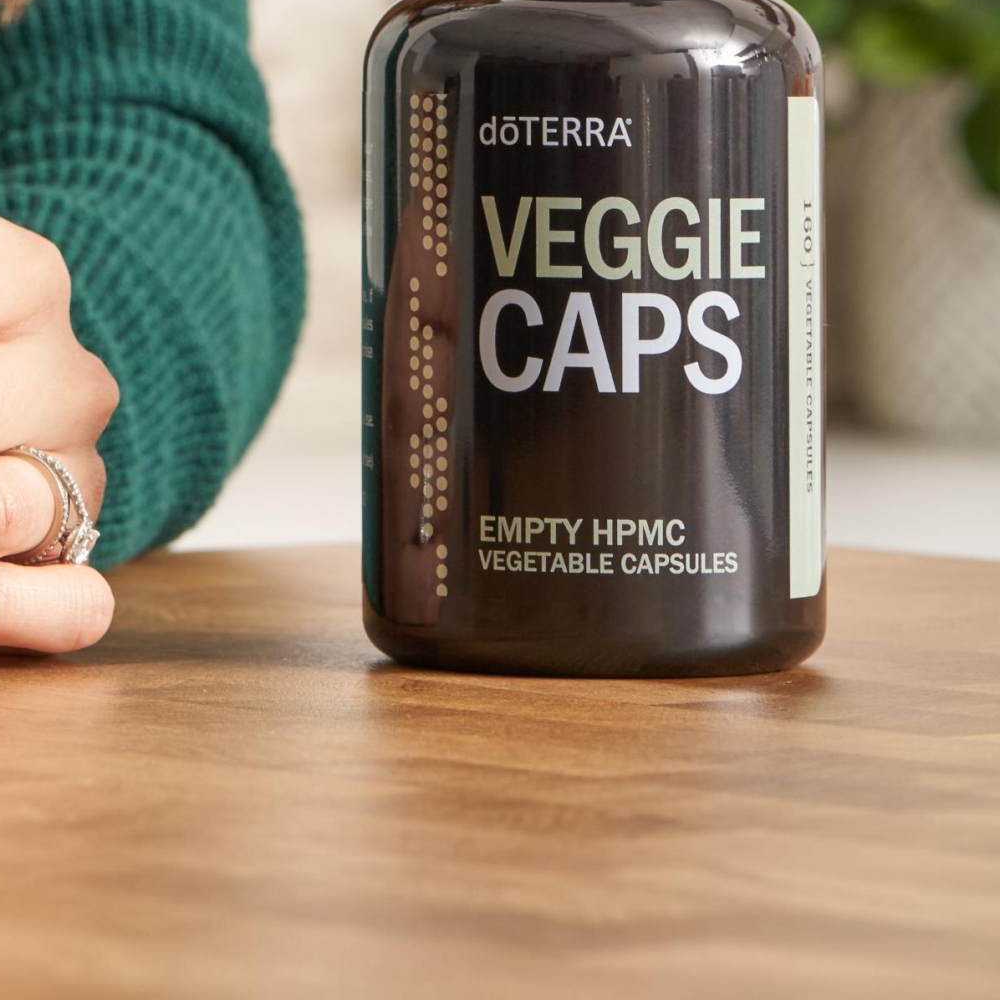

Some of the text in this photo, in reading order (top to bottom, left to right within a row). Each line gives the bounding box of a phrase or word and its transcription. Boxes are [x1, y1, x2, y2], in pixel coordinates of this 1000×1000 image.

[480, 195, 766, 281] VEGGIE
[803, 198, 813, 253] 160
[479, 288, 743, 395] CAPS
[805, 280, 813, 388] VEGETABLE
[478, 549, 738, 575] VEGETABLE CAPSULES
[479, 515, 686, 546] EMPTY HPMC
